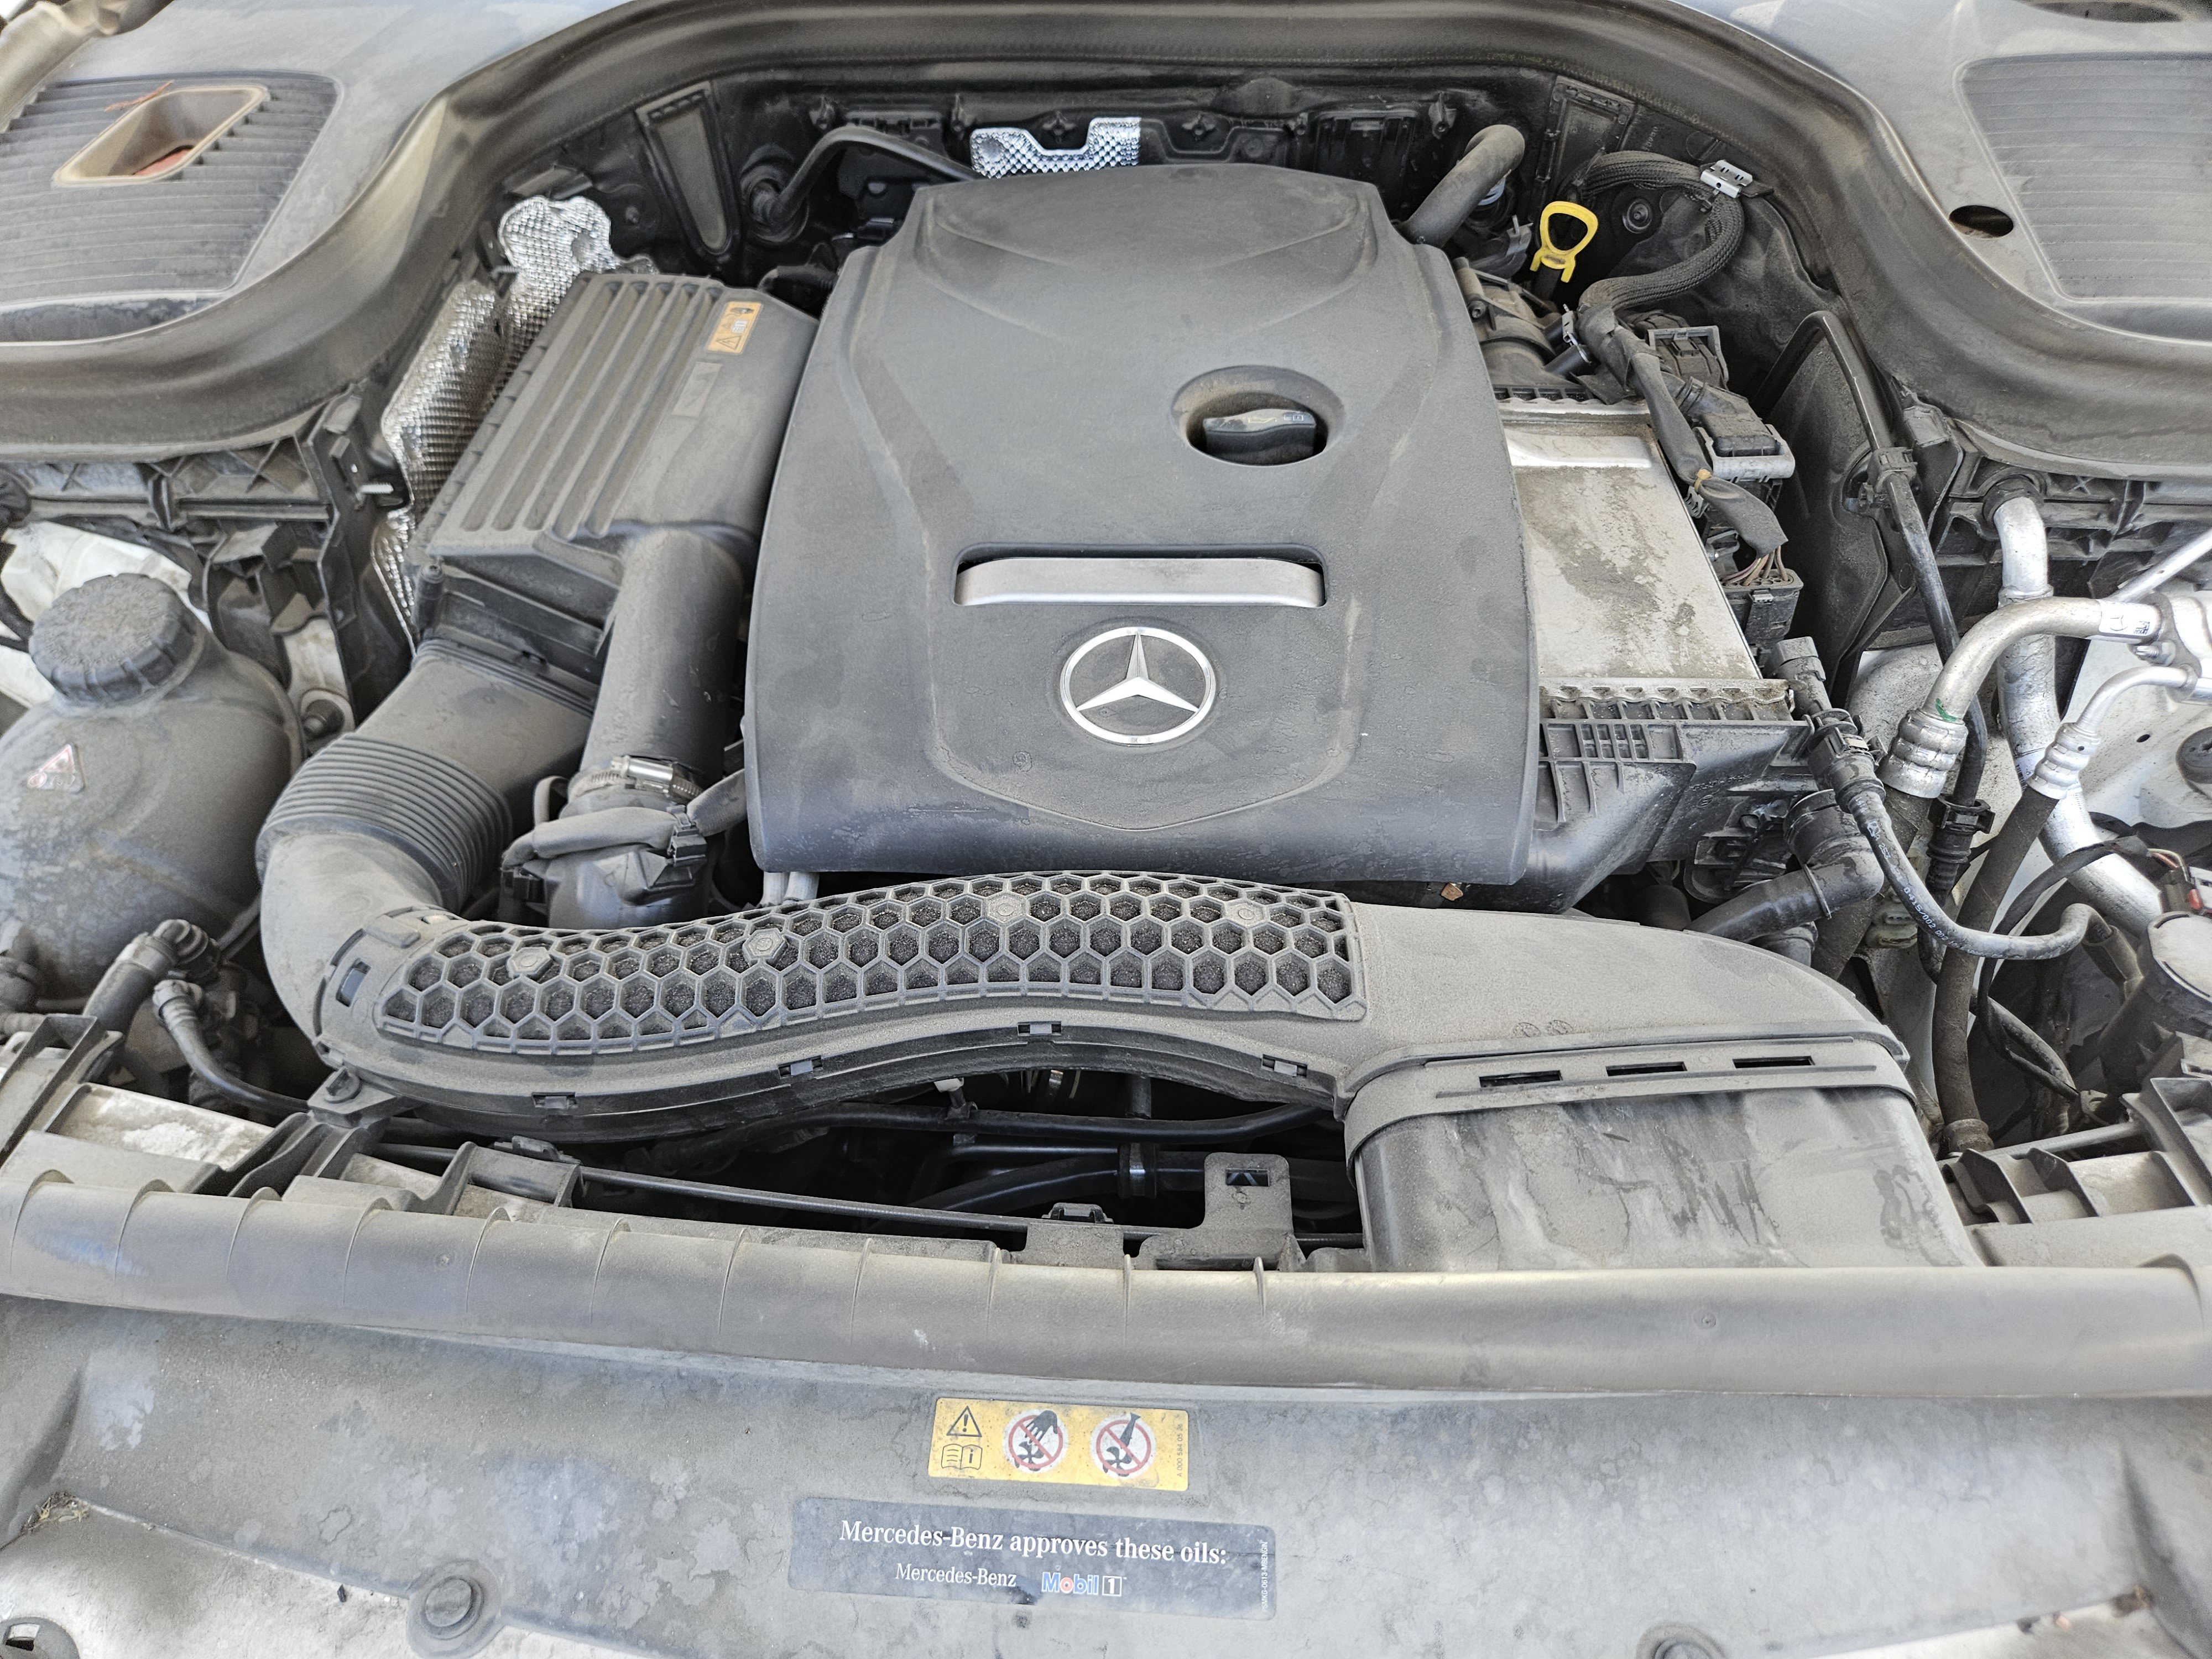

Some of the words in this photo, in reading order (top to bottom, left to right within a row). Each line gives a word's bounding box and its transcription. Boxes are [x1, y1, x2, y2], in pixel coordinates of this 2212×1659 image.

[1903, 886, 1936, 929] 0415/002
[1177, 1433, 1183, 1442] 05
[839, 1520, 1004, 1550] Mercedes-Benz
[1010, 1535, 1108, 1558] approves
[1115, 1537, 1175, 1561] these
[1180, 1541, 1227, 1564] oils:
[895, 1562, 1017, 1587] Mercedes-Benz
[1041, 1571, 1099, 1595] Mobil
